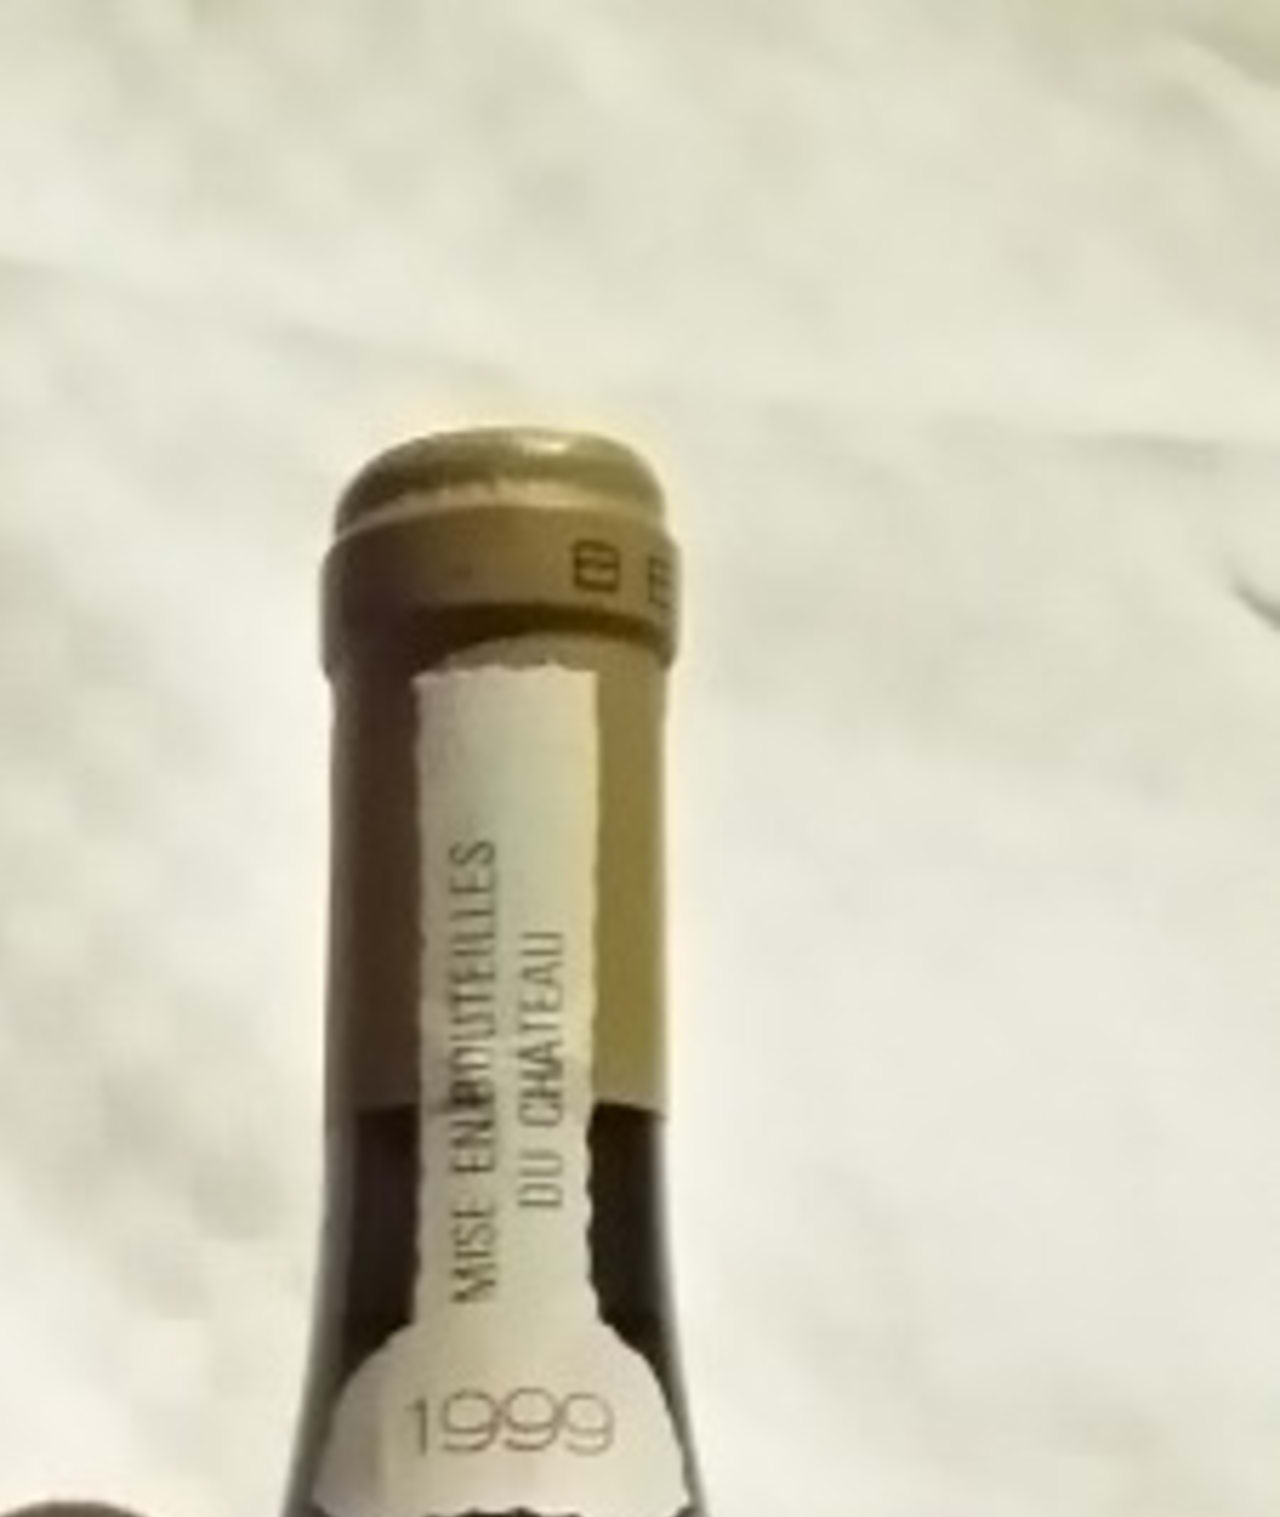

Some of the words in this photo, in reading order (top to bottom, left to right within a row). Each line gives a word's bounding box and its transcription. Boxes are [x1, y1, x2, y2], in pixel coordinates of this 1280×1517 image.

[447, 838, 497, 1108] BOUTEILLES
[449, 1115, 497, 1179] EN
[517, 1148, 565, 1211] DU
[450, 1202, 498, 1303] MISE
[405, 1387, 617, 1458] 1999
